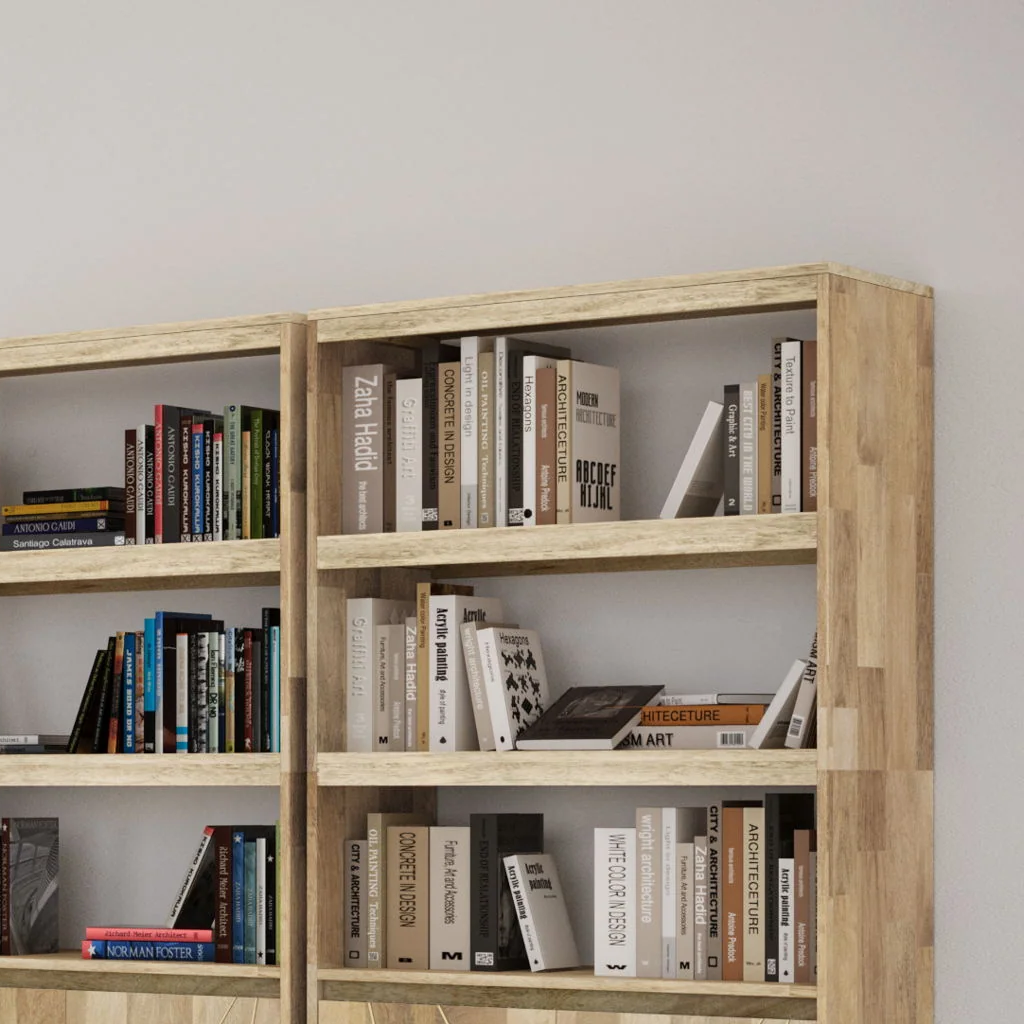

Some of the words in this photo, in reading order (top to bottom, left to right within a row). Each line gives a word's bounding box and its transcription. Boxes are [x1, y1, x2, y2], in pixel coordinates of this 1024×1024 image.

[463, 356, 474, 384] Light
[774, 342, 782, 369] CITY
[480, 370, 488, 392] OIL
[785, 356, 796, 393] Texture
[354, 375, 378, 418] Zaha
[444, 369, 455, 428] CONCRETE
[463, 387, 474, 396] in
[523, 376, 534, 433] Hexagons
[576, 390, 598, 408] MODERN
[742, 390, 753, 414] BEST
[785, 396, 796, 405] to
[463, 400, 474, 437] design
[480, 393, 488, 450] PAINTING
[557, 374, 567, 483] ARCHITECETURE
[576, 408, 616, 427] ARCHITECTURE
[726, 404, 737, 435] Graphic
[774, 386, 782, 477] ARCHITECTURE
[785, 409, 796, 435] Paint
[167, 426, 175, 472] ANTONIO
[354, 423, 378, 471] Hadid
[444, 430, 455, 441] IN
[726, 435, 737, 443] &
[126, 443, 135, 484] ANTONIO
[444, 443, 455, 484] DESIGN
[726, 444, 737, 458] Art
[480, 454, 488, 509] Techniques
[576, 459, 616, 487] ABCDEF
[728, 498, 736, 507] 2
[14, 521, 49, 533] ANTONIO
[12, 538, 50, 549] Santiago
[52, 537, 93, 547] Calatrava
[435, 608, 448, 640] Acrylic
[405, 625, 417, 659] Zaha
[499, 632, 529, 648] Hexagons
[435, 643, 448, 682] painting
[803, 660, 818, 684] ART
[352, 675, 368, 697] Art
[405, 663, 417, 701] Hadid
[641, 710, 720, 721] HITECETURE
[646, 733, 674, 746] ART
[639, 814, 655, 850] wright
[709, 806, 718, 833] CITY
[368, 829, 378, 848] OIL
[608, 834, 626, 863] WHITE
[709, 836, 718, 844] &
[219, 846, 228, 875] Richard
[351, 844, 360, 864] CITY
[399, 832, 416, 881] CONCRETE
[695, 846, 707, 880] Zaha
[368, 849, 378, 897] PAINTING
[399, 883, 416, 892] IN
[508, 865, 519, 889] Acrylic
[529, 878, 553, 891] painting
[608, 866, 626, 897] COLOR
[749, 823, 759, 935] ARCHITECETURE
[780, 868, 790, 894] Acrylic
[219, 877, 228, 899] Meier
[639, 854, 655, 924] architecture
[709, 848, 718, 938] ARCHITECTURE
[219, 901, 228, 937] Architect
[351, 874, 360, 938] ARCHITECTURE
[399, 894, 416, 928] DESIGN
[513, 890, 528, 920] painting
[608, 900, 626, 909] IN
[695, 885, 707, 925] Hadid
[780, 895, 790, 927] painting
[368, 902, 378, 949] Techniques
[608, 912, 626, 946] DESIGN
[107, 944, 154, 959] NORMAN
[155, 944, 192, 959] FOSTER
